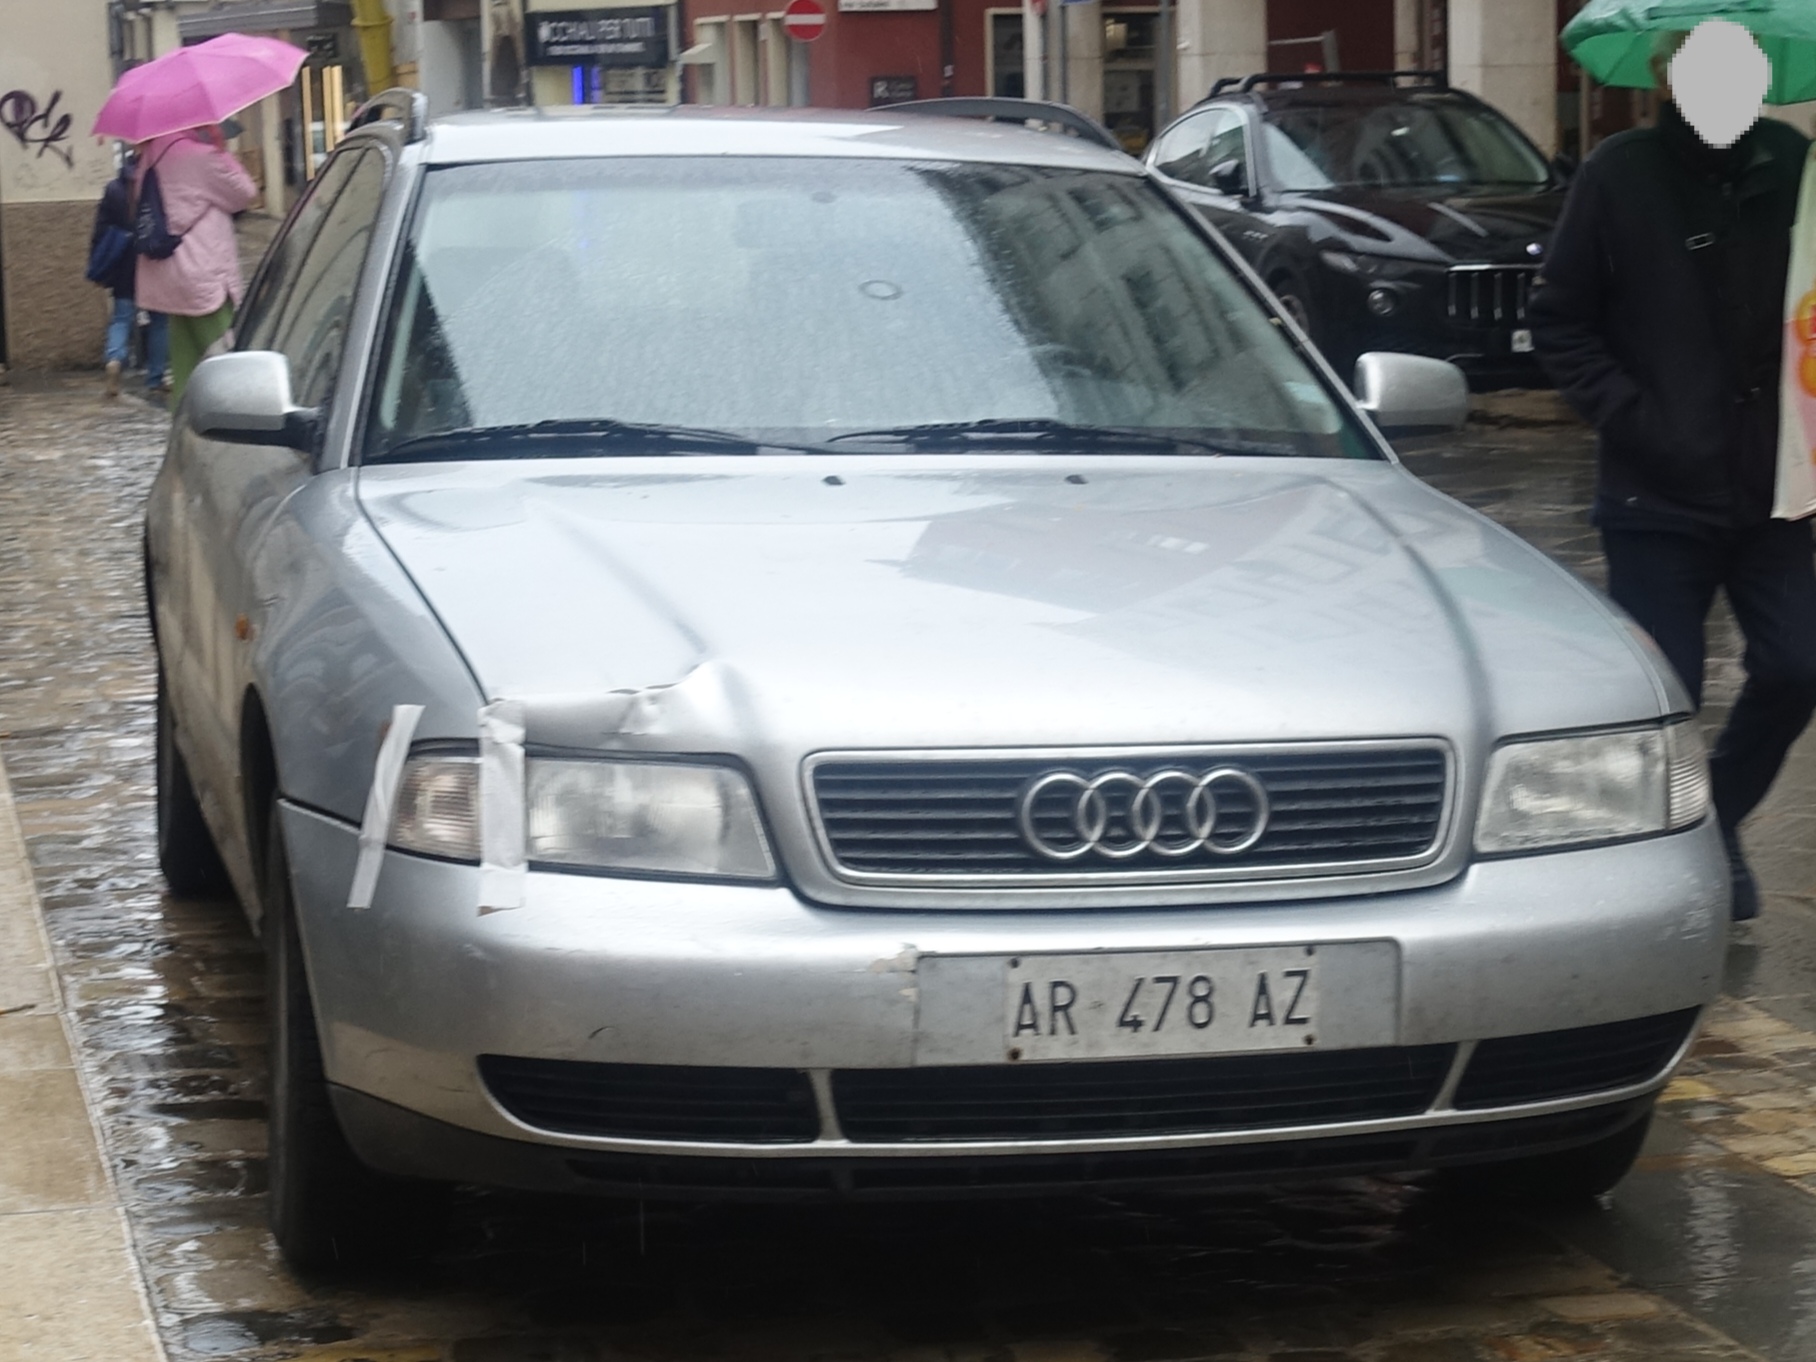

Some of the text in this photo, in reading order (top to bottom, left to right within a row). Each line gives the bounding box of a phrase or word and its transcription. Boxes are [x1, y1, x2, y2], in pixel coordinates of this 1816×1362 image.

[1013, 969, 1311, 1038] AR 478 AZ
